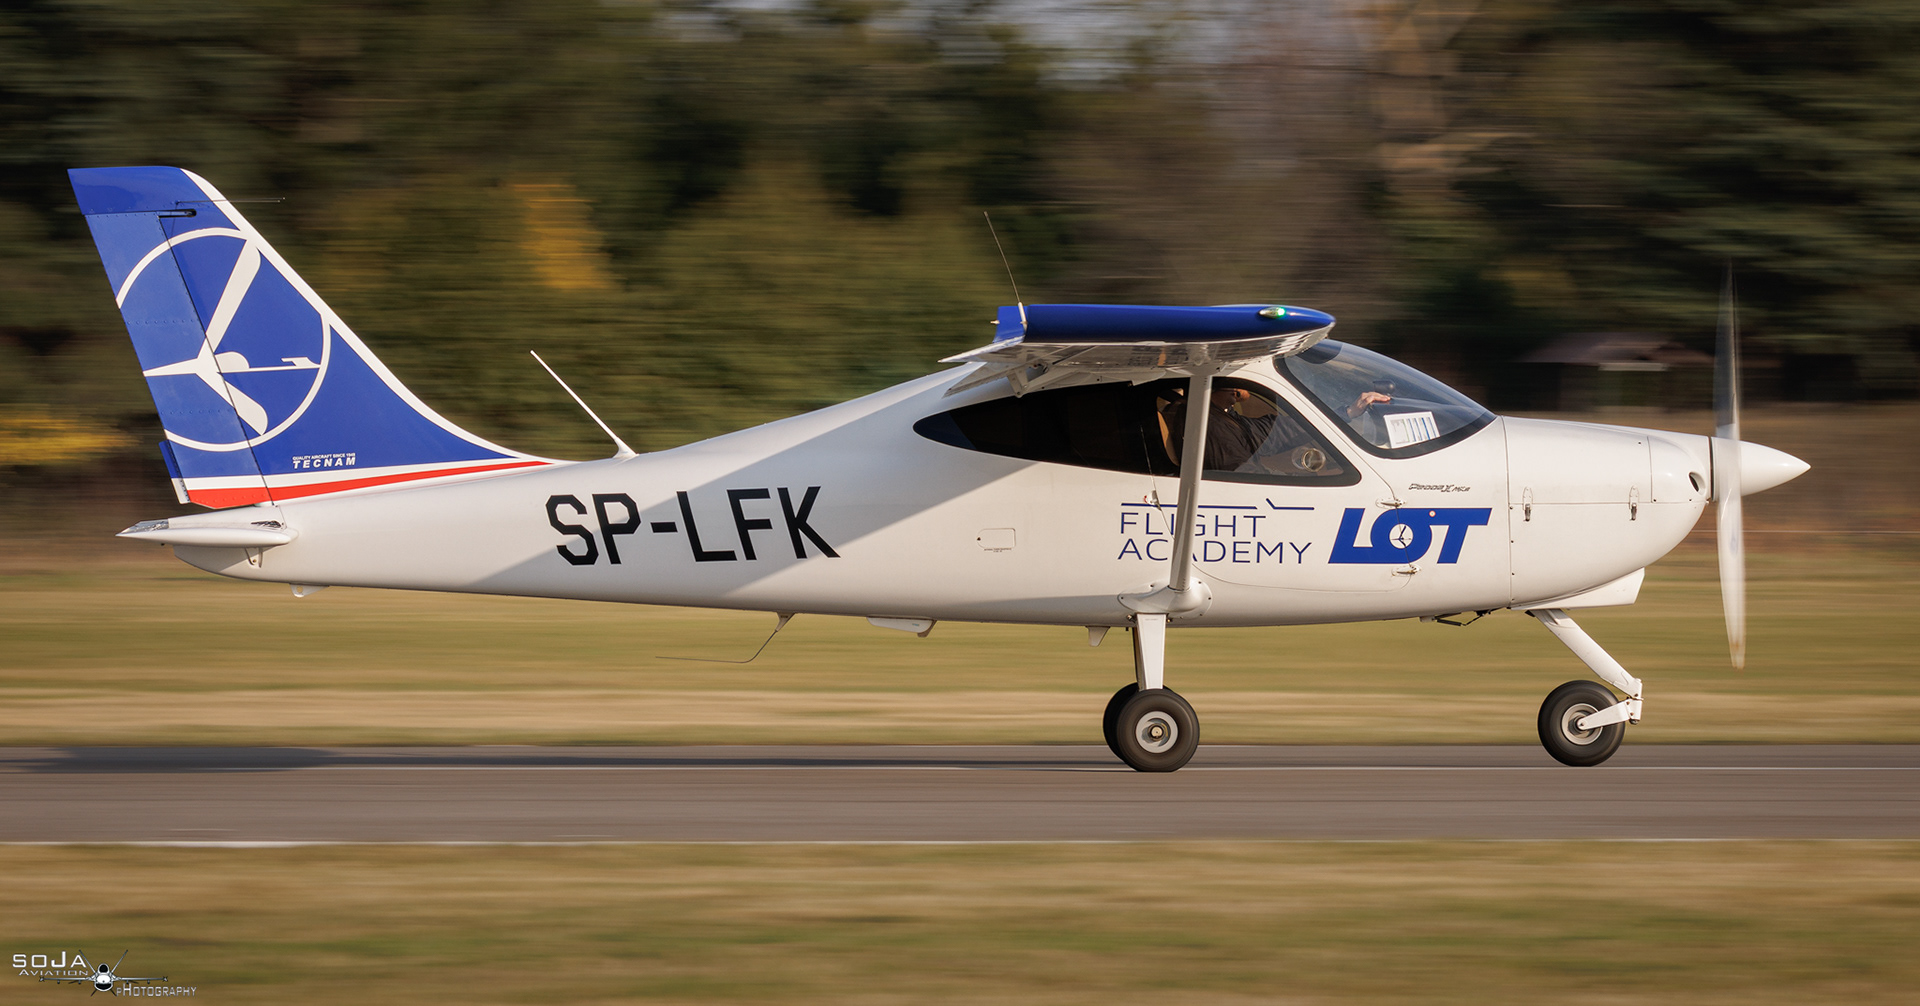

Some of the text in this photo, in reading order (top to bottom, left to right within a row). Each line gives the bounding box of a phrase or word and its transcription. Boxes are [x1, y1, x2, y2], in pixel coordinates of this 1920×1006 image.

[293, 457, 356, 469] TECNAM
[545, 486, 841, 566] SP-LFK
[1328, 507, 1493, 564] LOT
[1117, 538, 1312, 564] ACDEMY
